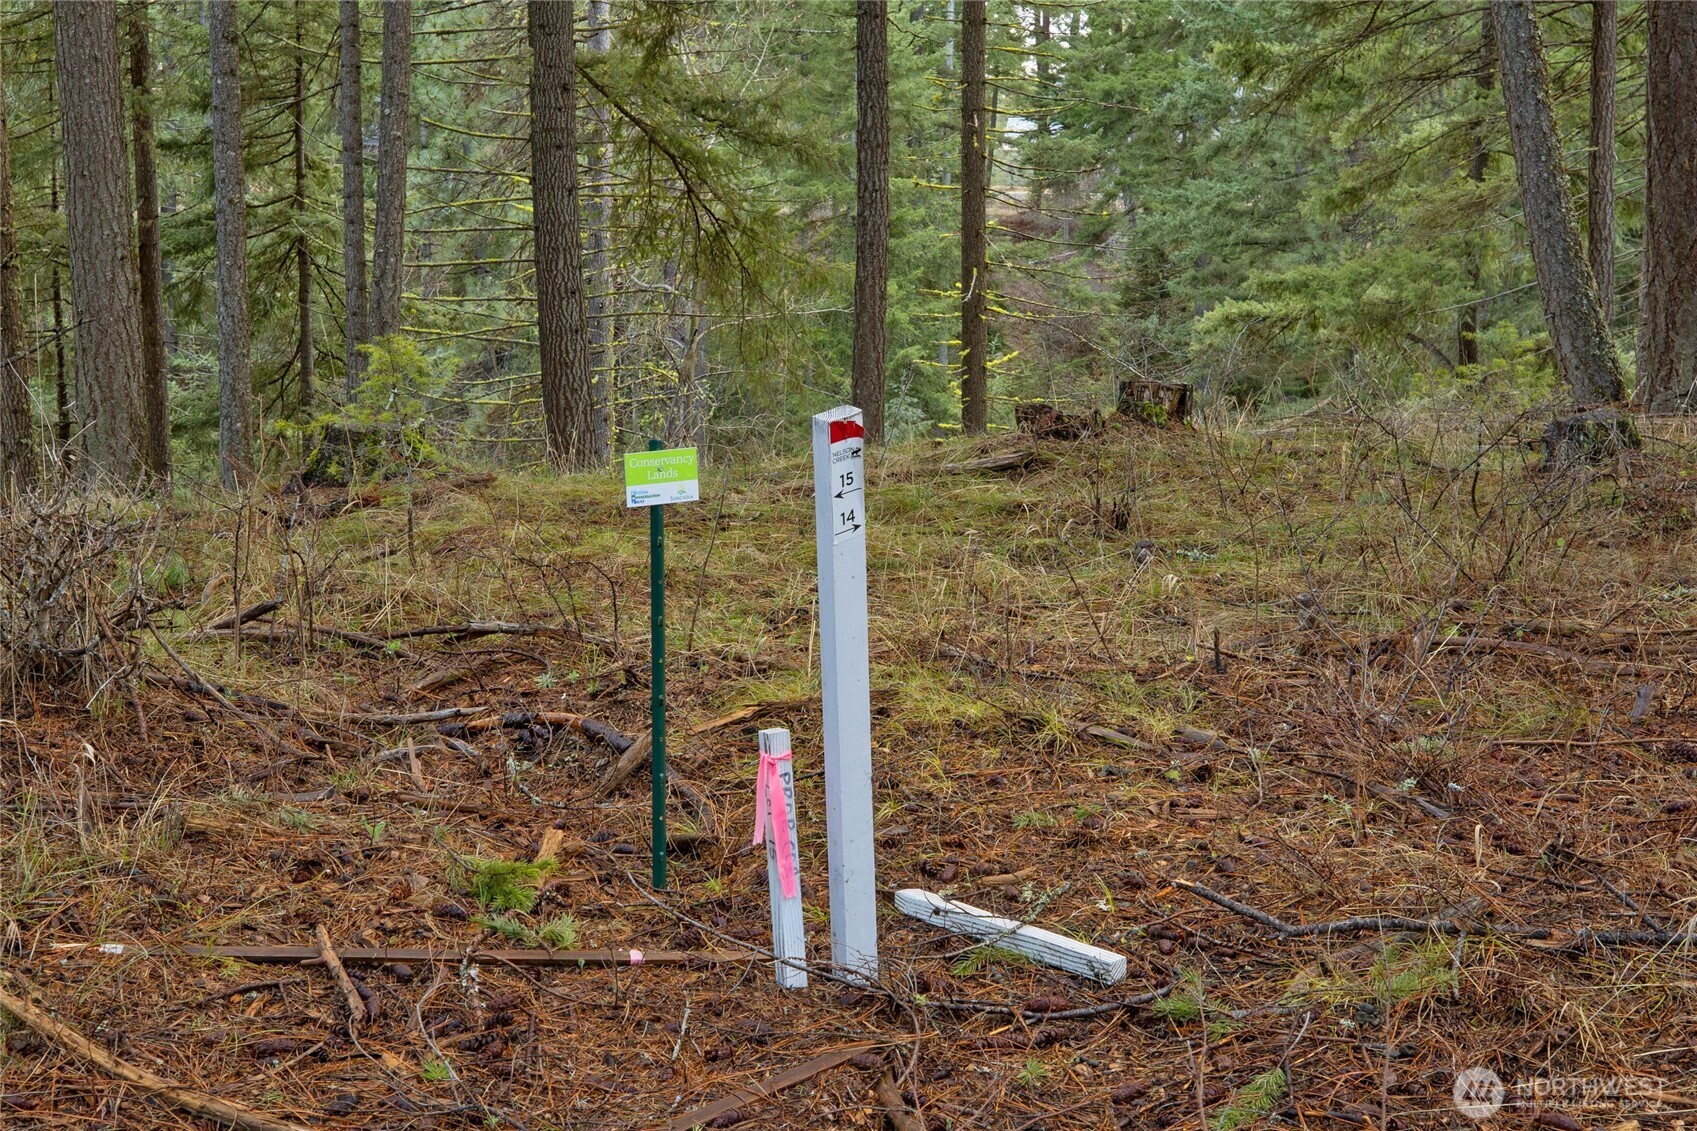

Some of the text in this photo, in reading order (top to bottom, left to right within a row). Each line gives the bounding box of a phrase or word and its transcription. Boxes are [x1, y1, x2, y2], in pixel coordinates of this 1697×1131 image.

[629, 455, 694, 468] Conservancy
[832, 453, 851, 464] CREEK
[647, 467, 678, 480] Lands
[839, 471, 854, 488] 15
[840, 509, 855, 526] 14
